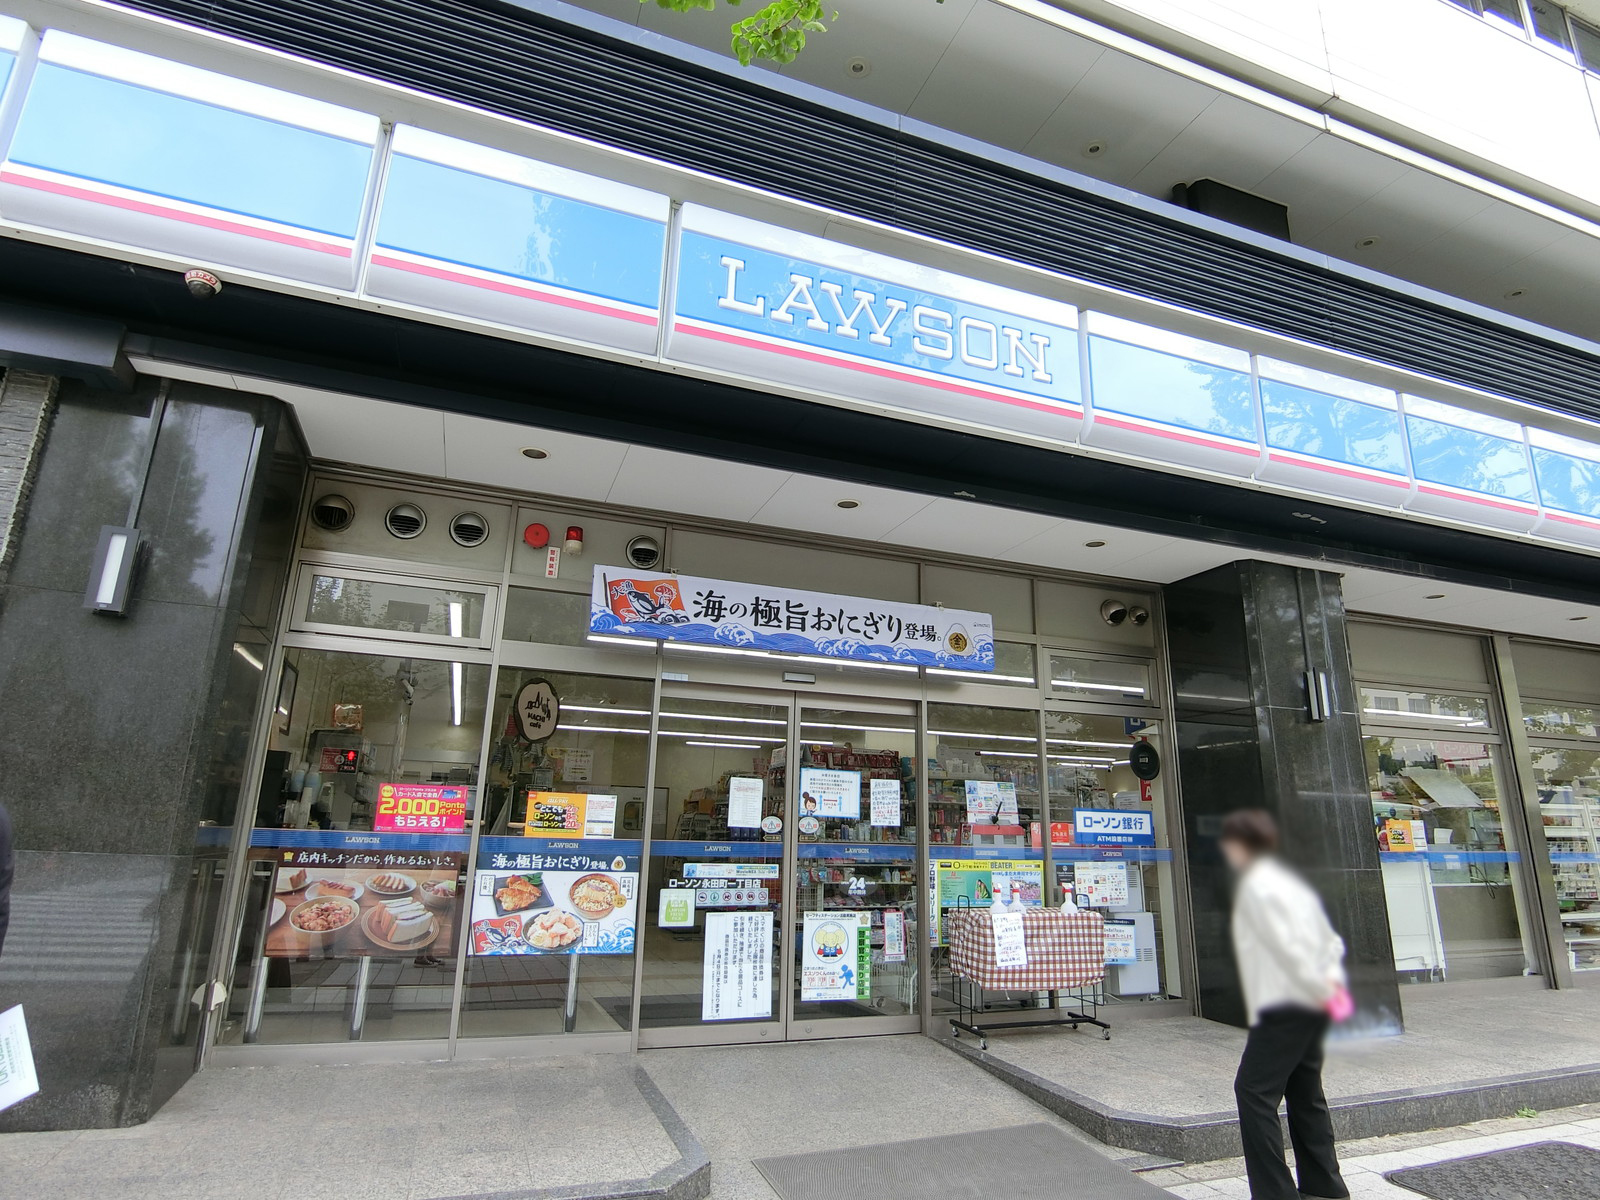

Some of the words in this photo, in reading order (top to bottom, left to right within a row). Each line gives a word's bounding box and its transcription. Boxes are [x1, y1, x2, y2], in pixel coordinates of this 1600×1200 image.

[718, 254, 1053, 385] LAWSON
[610, 580, 634, 599] 大漁
[692, 590, 942, 643] 海の極旨おにぎり登場。
[527, 712, 546, 723] MACHI
[379, 798, 440, 816] 2,000
[439, 801, 465, 809] Ponta
[439, 808, 465, 816] ポイント
[1083, 816, 1144, 830] ローソン銀行
[345, 836, 381, 844] LAWSON
[990, 861, 1013, 870] BEATER
[669, 878, 701, 888] ローソン
[701, 878, 762, 888] 永田町一丁目店
[849, 876, 866, 889] 24
